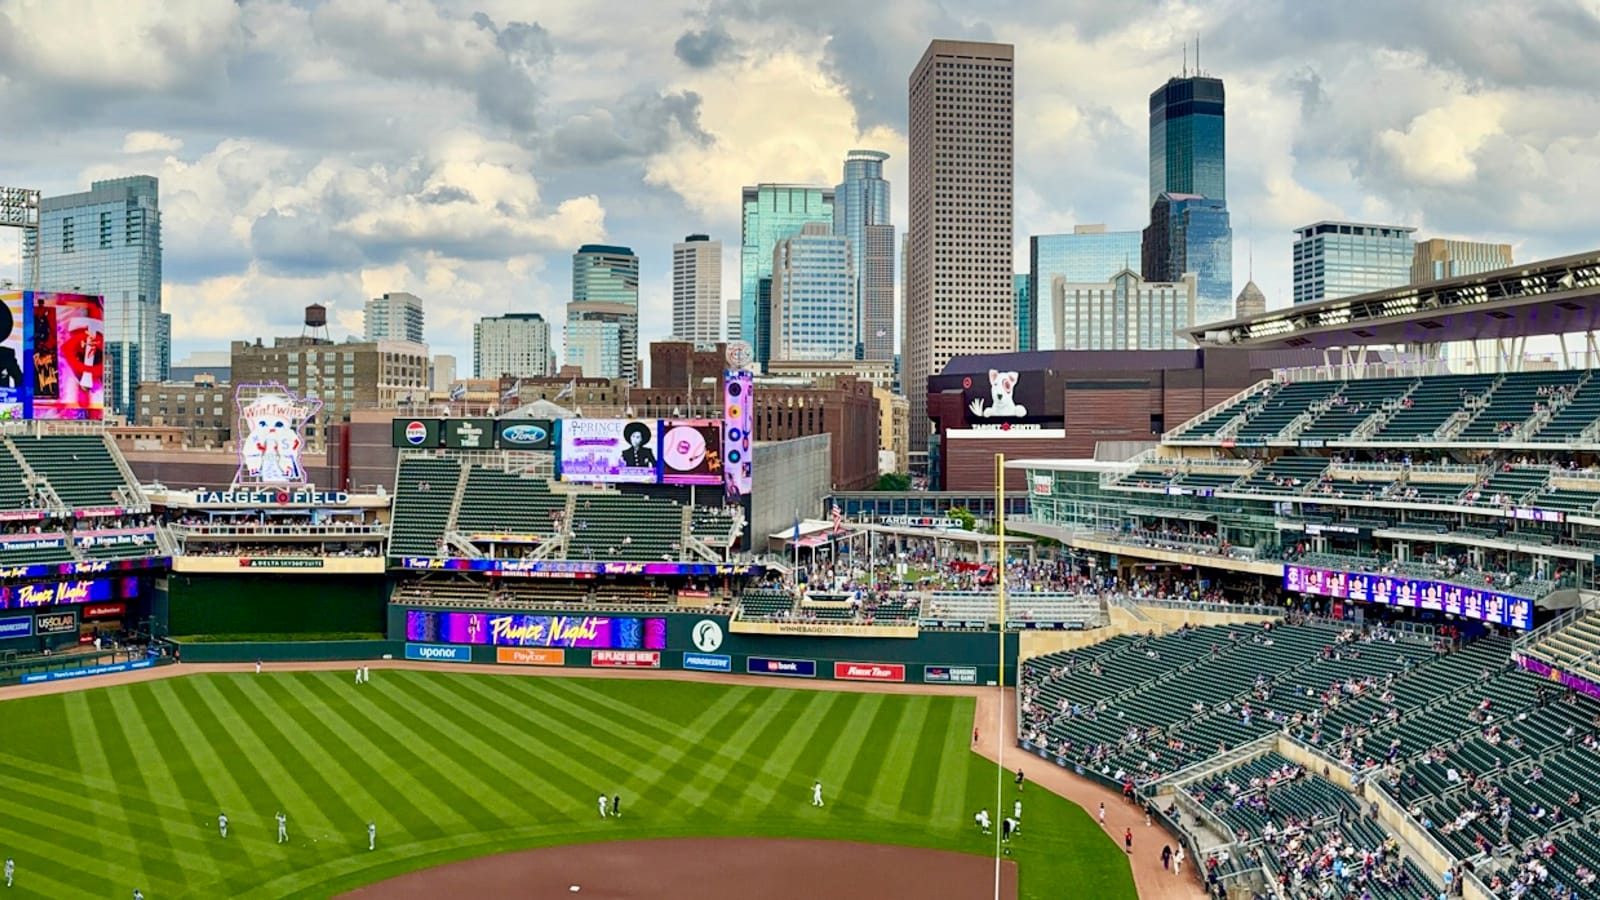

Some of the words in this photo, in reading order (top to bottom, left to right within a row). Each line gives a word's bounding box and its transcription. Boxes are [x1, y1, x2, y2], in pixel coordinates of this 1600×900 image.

[246, 404, 270, 419] Win!
[272, 403, 307, 419] Twins!
[580, 422, 621, 433] PRINCE
[510, 428, 537, 441] Ford
[197, 491, 274, 504] TARGET
[294, 491, 350, 505] FIELD
[880, 515, 919, 526] TARGET
[932, 517, 963, 526] FIELD
[3, 540, 35, 550] Treasure
[36, 539, 58, 549] Island
[18, 585, 54, 608] Prince
[54, 580, 94, 605] Night
[490, 615, 543, 645] Prince
[545, 615, 609, 648] Night
[419, 647, 456, 659] uponor
[514, 652, 546, 662] Paycor
[686, 657, 728, 667] PROGRESSIVE
[778, 661, 797, 671] bank
